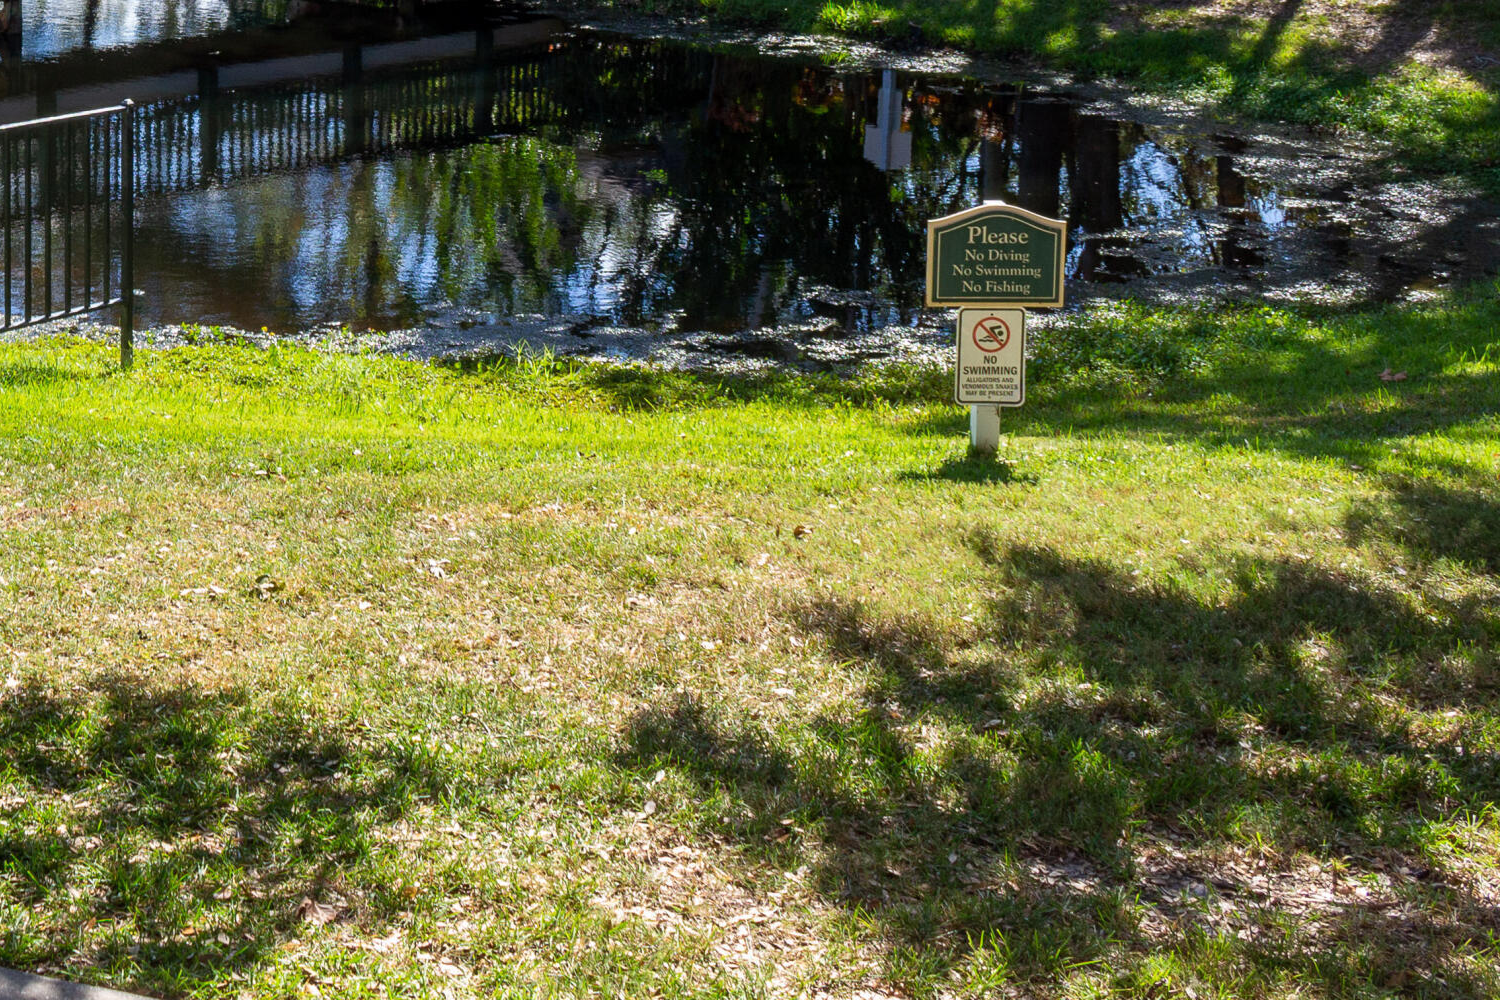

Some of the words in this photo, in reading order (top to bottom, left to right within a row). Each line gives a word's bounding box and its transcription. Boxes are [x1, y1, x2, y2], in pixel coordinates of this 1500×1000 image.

[967, 226, 1029, 244] Please
[965, 249, 985, 261] No
[988, 249, 1030, 263] Diving
[952, 264, 972, 276] No
[975, 264, 1042, 278] Swimming
[962, 280, 982, 292] No
[985, 280, 1031, 295] Fishing
[983, 356, 998, 364] NO
[963, 366, 1018, 375] SWIMMING
